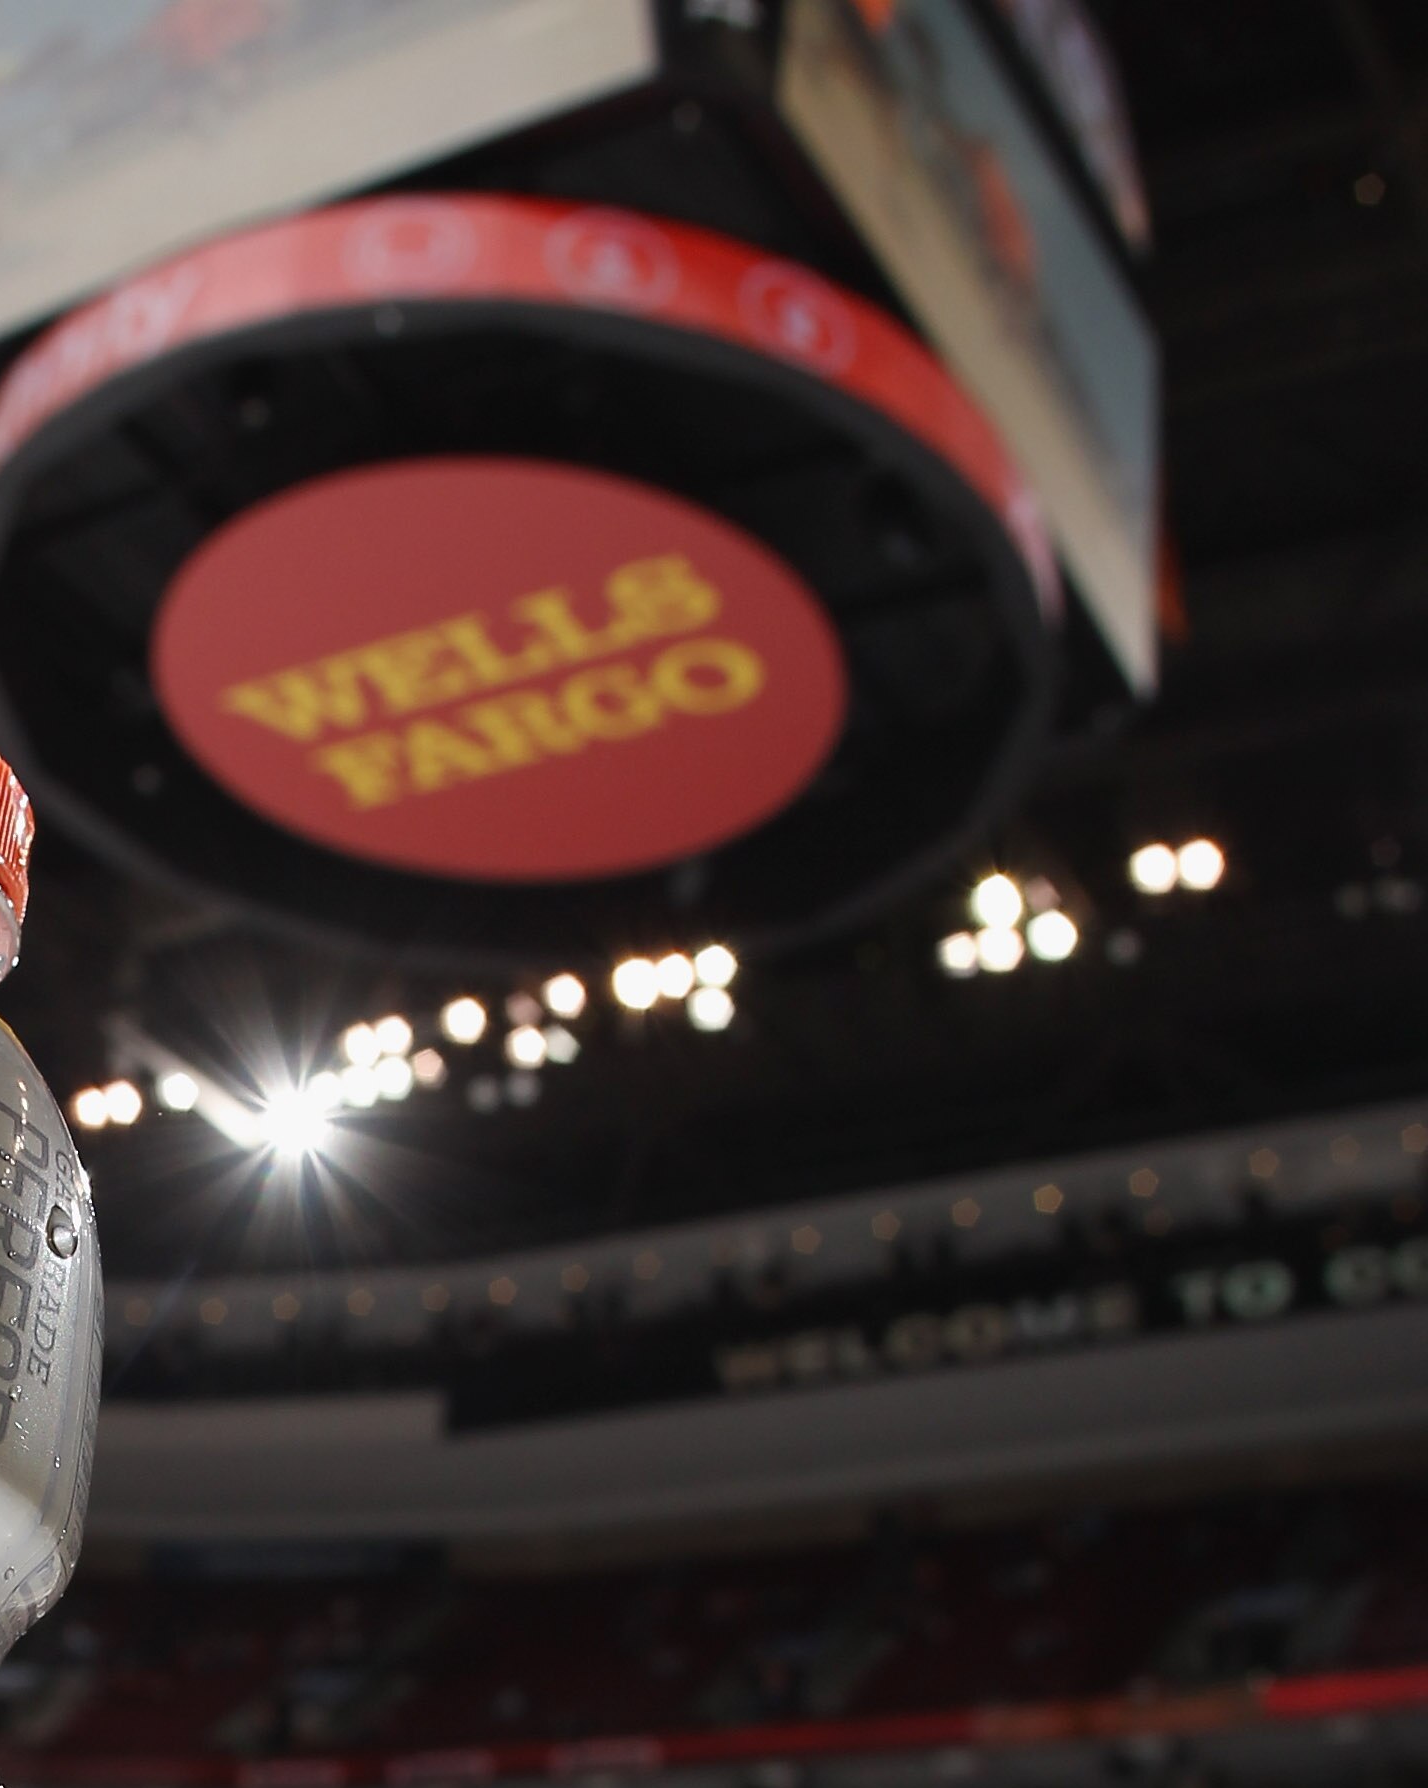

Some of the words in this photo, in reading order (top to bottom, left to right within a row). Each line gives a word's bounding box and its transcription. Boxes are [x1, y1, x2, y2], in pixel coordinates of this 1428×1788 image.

[222, 554, 721, 740] WELLS
[312, 638, 764, 810] FARGO
[1174, 1260, 1294, 1323] TO
